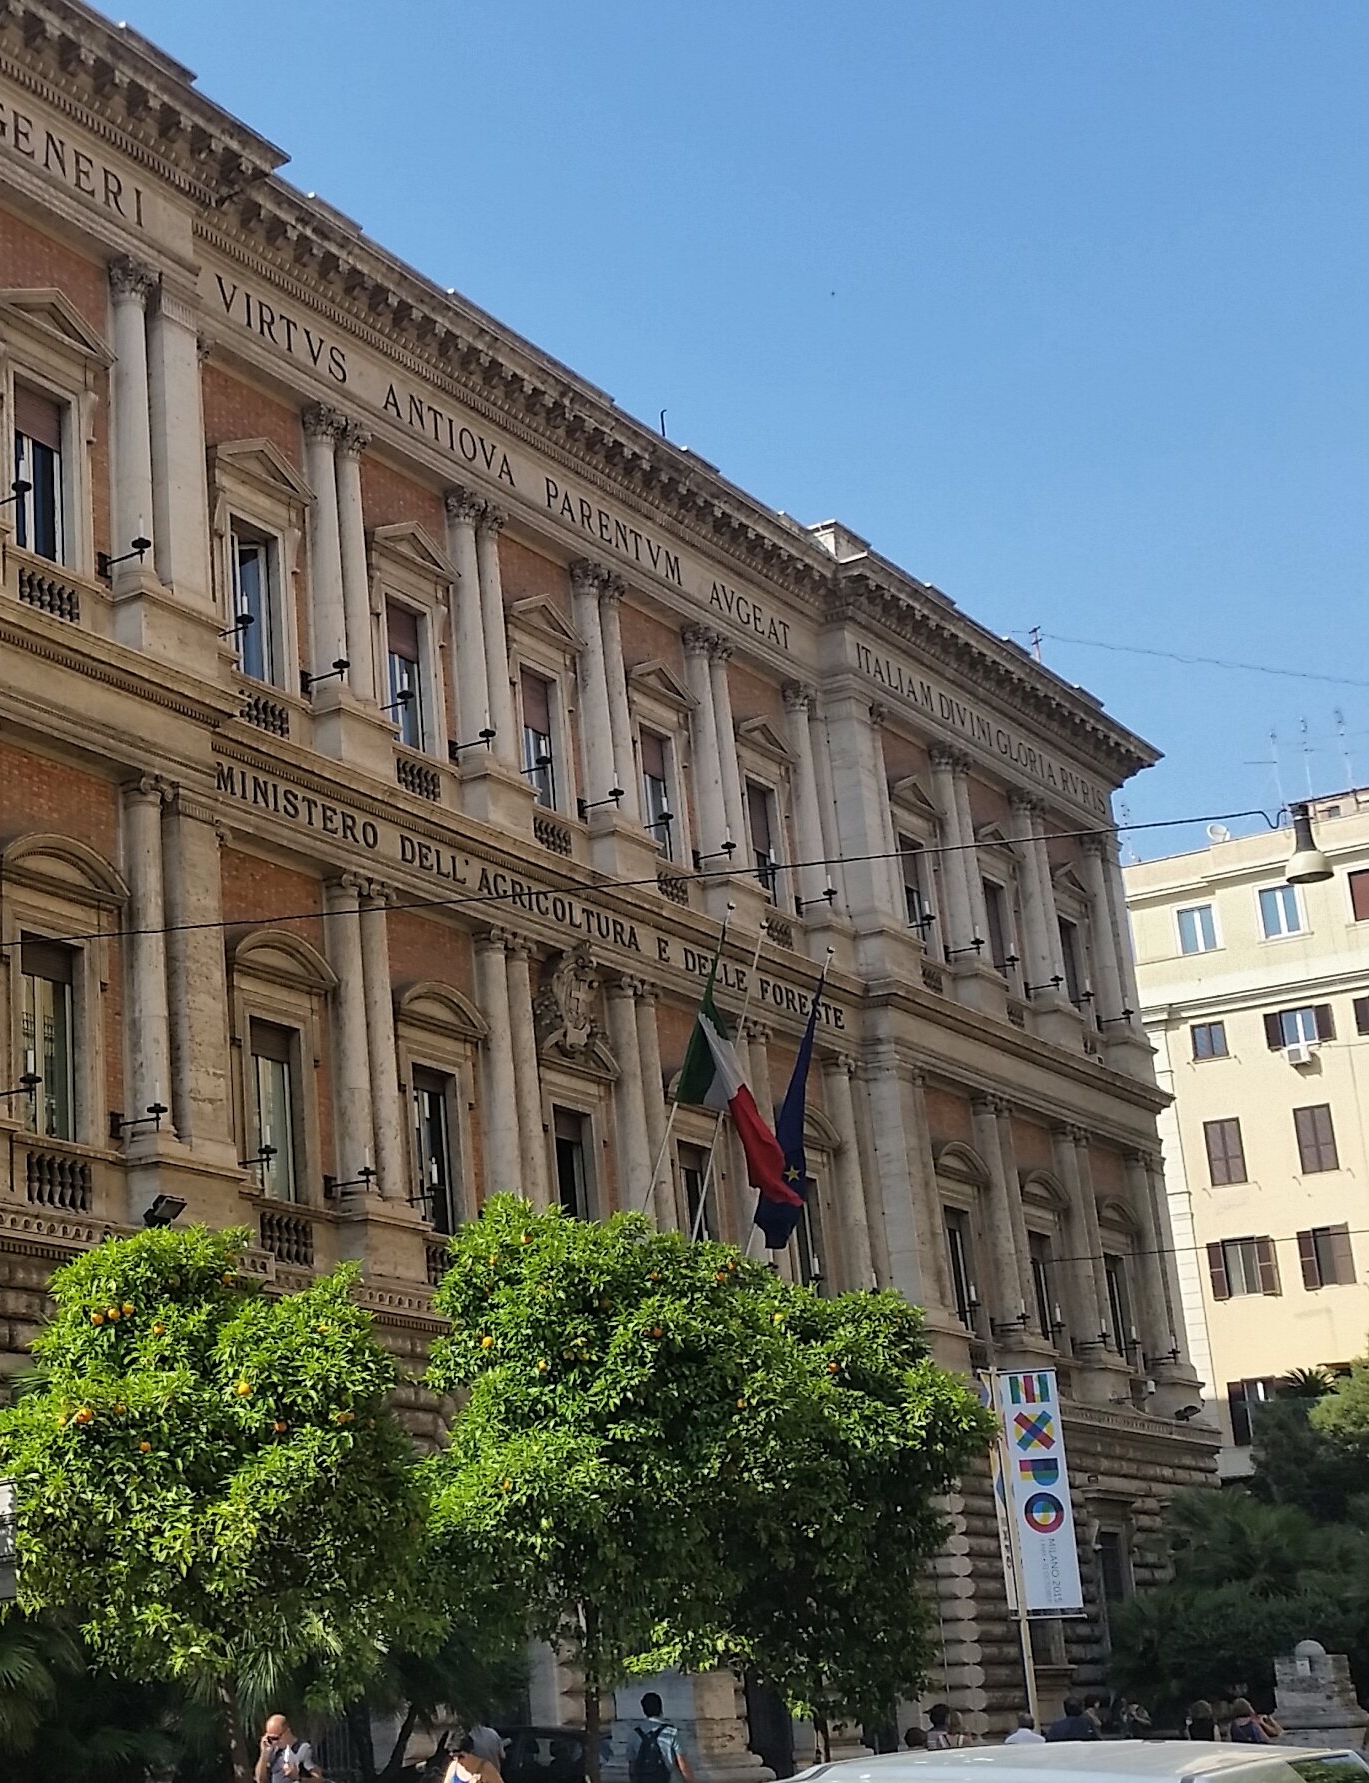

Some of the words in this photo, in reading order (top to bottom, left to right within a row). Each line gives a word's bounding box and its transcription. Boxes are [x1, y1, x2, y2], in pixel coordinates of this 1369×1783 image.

[215, 272, 348, 384] VIRTVS
[545, 476, 683, 587] PARENTVM
[709, 580, 791, 650] AVGEAT
[855, 642, 934, 712] ITALIAM
[938, 692, 993, 747] DIVINI
[996, 729, 1057, 786] GLORIA
[1059, 766, 1106, 815] RVRIS
[215, 761, 379, 850] MINISTERO
[477, 867, 641, 952] AGRICOLTURA
[656, 936, 671, 963] E
[683, 947, 748, 993] DELLE
[758, 977, 846, 1031] FORESTE
[1009, 1374, 1065, 1534] EXPO
[1048, 1538, 1060, 1578] MILANO
[1052, 1580, 1063, 1603] 2015
